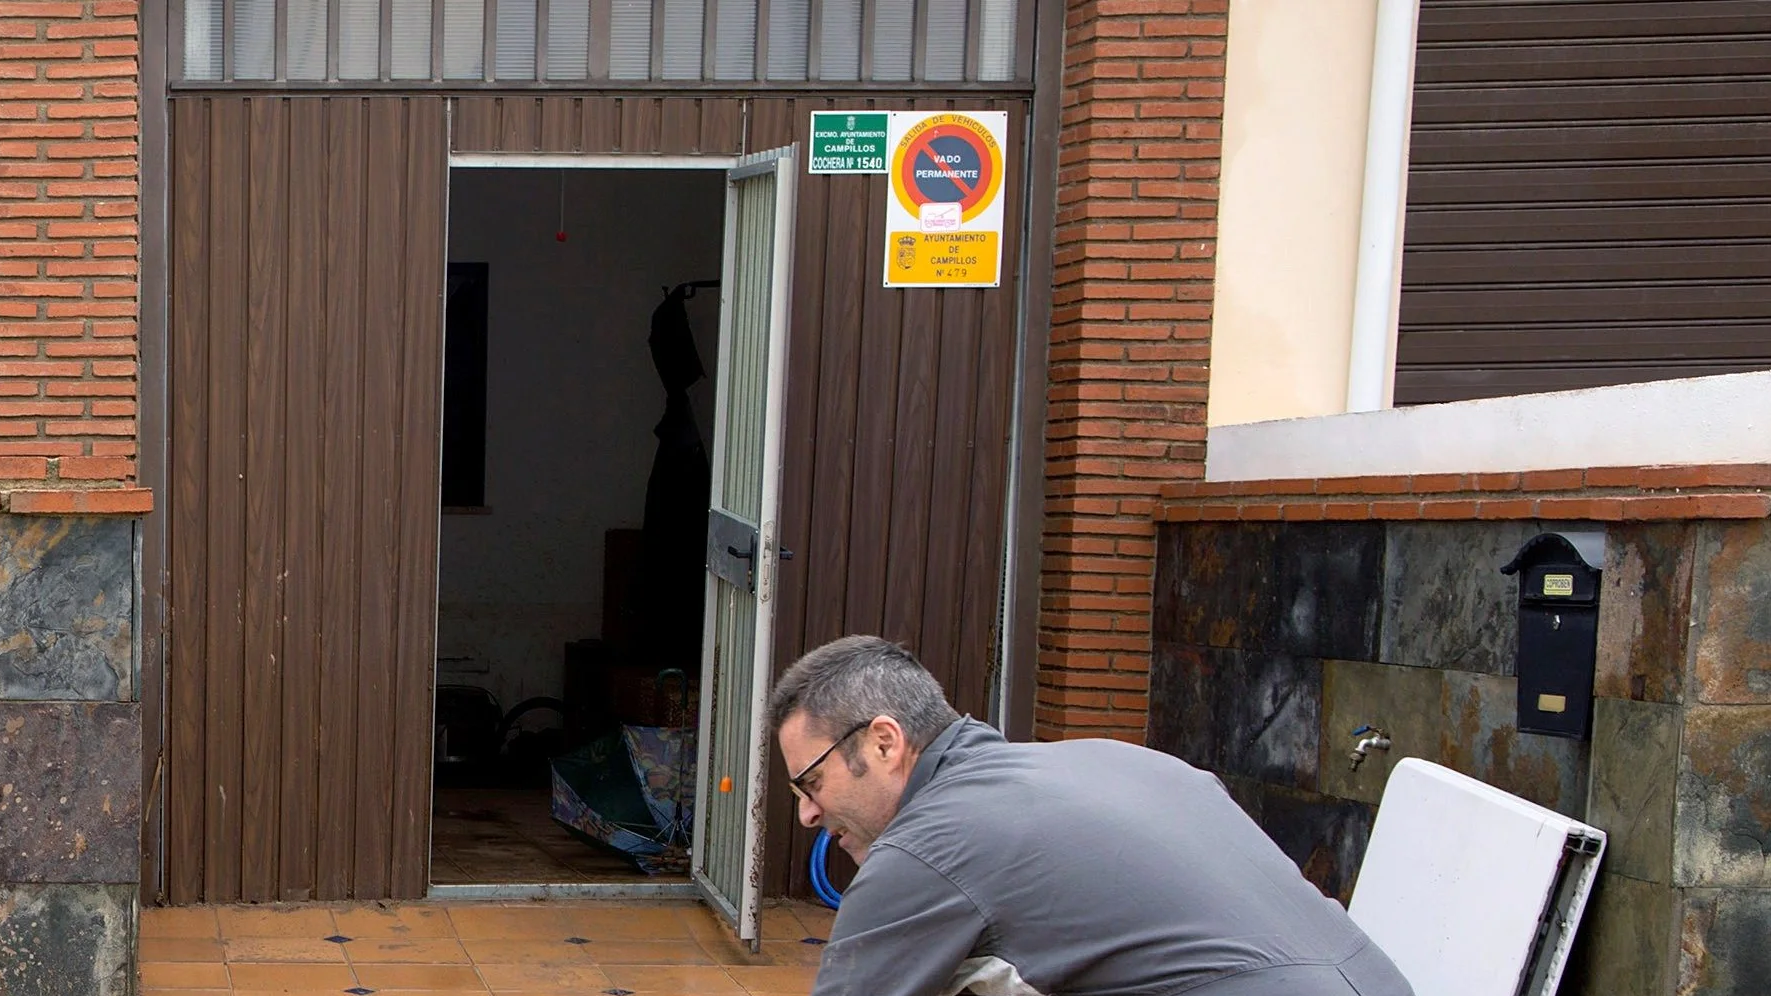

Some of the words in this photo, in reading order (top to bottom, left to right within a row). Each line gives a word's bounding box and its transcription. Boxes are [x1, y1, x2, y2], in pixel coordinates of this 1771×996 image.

[900, 122, 927, 148] SALIDA
[932, 115, 945, 125] DE
[813, 157, 845, 168] COCHERA
[857, 157, 882, 168] 1540
[933, 155, 961, 163] VADO
[916, 169, 978, 178] PERMANENTE
[924, 234, 986, 242] AYUNTAMIENTO
[930, 256, 977, 265] CAMPILLOS
[947, 268, 968, 277] 479
